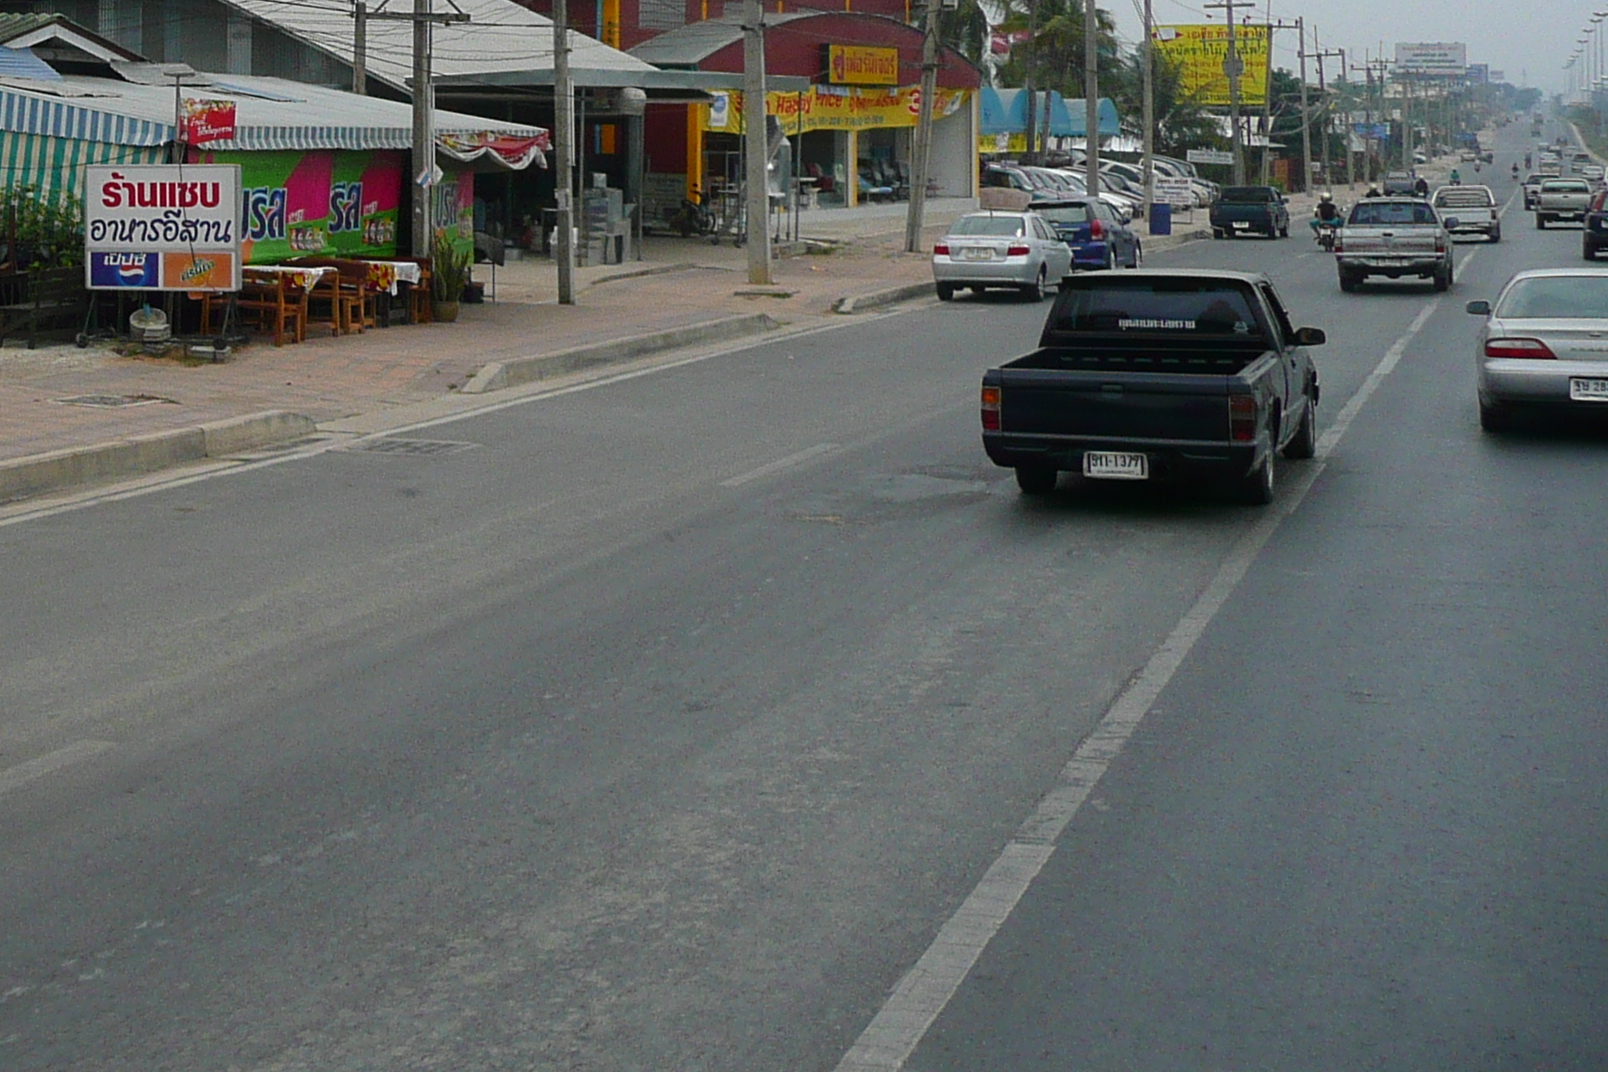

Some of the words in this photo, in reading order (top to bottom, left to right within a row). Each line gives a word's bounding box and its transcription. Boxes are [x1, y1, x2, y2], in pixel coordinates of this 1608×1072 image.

[101, 171, 221, 208] ร้านแซบ
[90, 208, 232, 243] อาหารอีสาน
